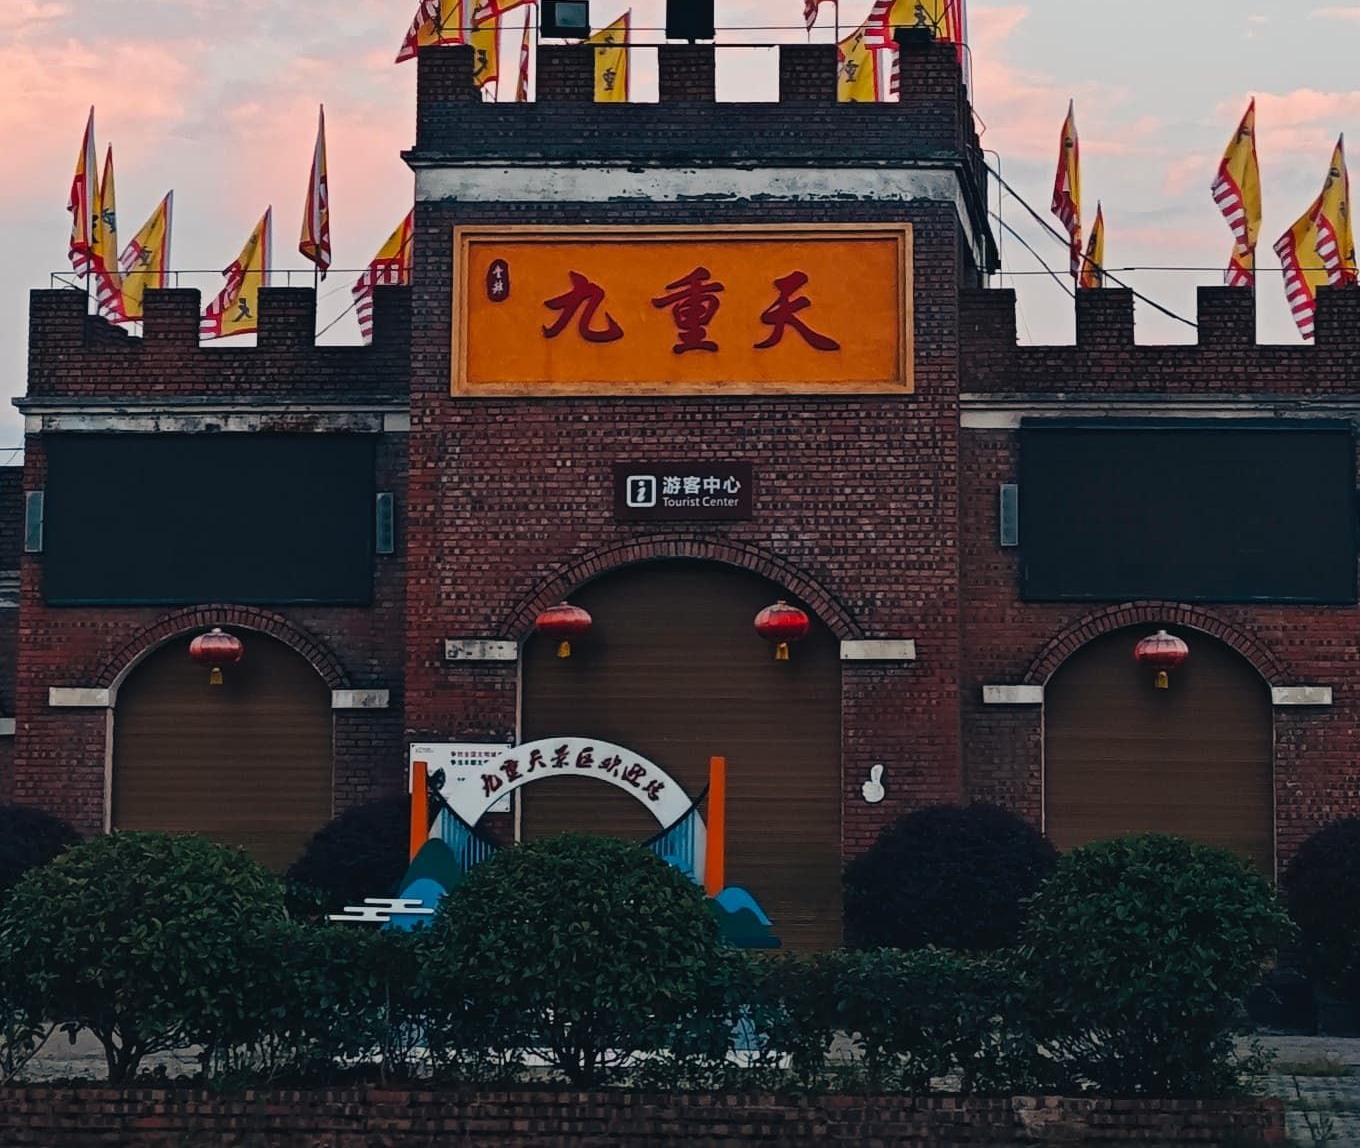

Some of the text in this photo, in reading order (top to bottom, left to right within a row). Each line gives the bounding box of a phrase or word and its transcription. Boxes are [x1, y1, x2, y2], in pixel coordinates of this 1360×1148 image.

[542, 266, 841, 354] 九重天
[662, 475, 742, 495] 游客中心
[663, 496, 739, 507] Tourist Center
